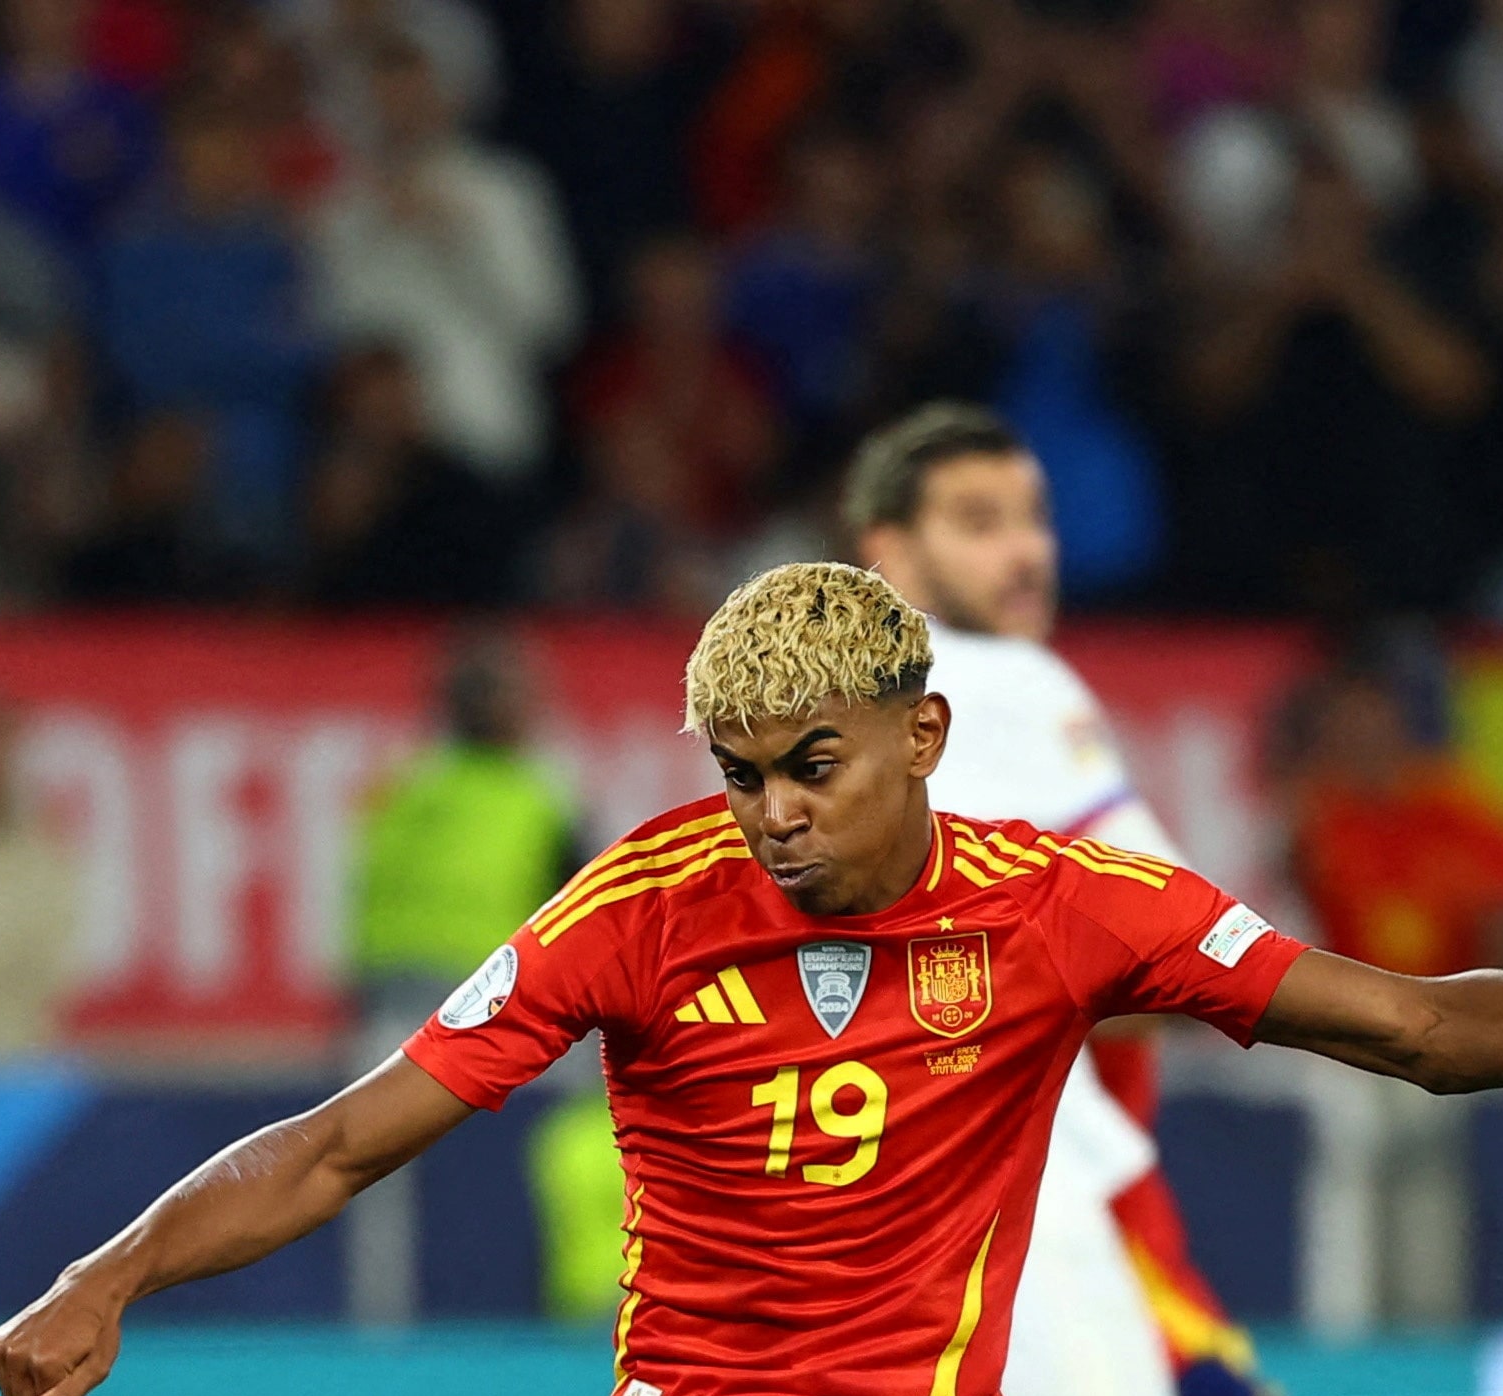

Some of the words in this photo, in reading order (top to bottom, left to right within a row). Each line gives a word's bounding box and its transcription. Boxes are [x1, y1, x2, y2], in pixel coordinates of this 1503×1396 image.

[804, 952, 865, 962] EUROPEAN
[804, 962, 864, 972] CHAMPIONS
[819, 1001, 849, 1013] 2024
[930, 1063, 974, 1076] STUTTGART
[752, 1060, 888, 1187] 19
